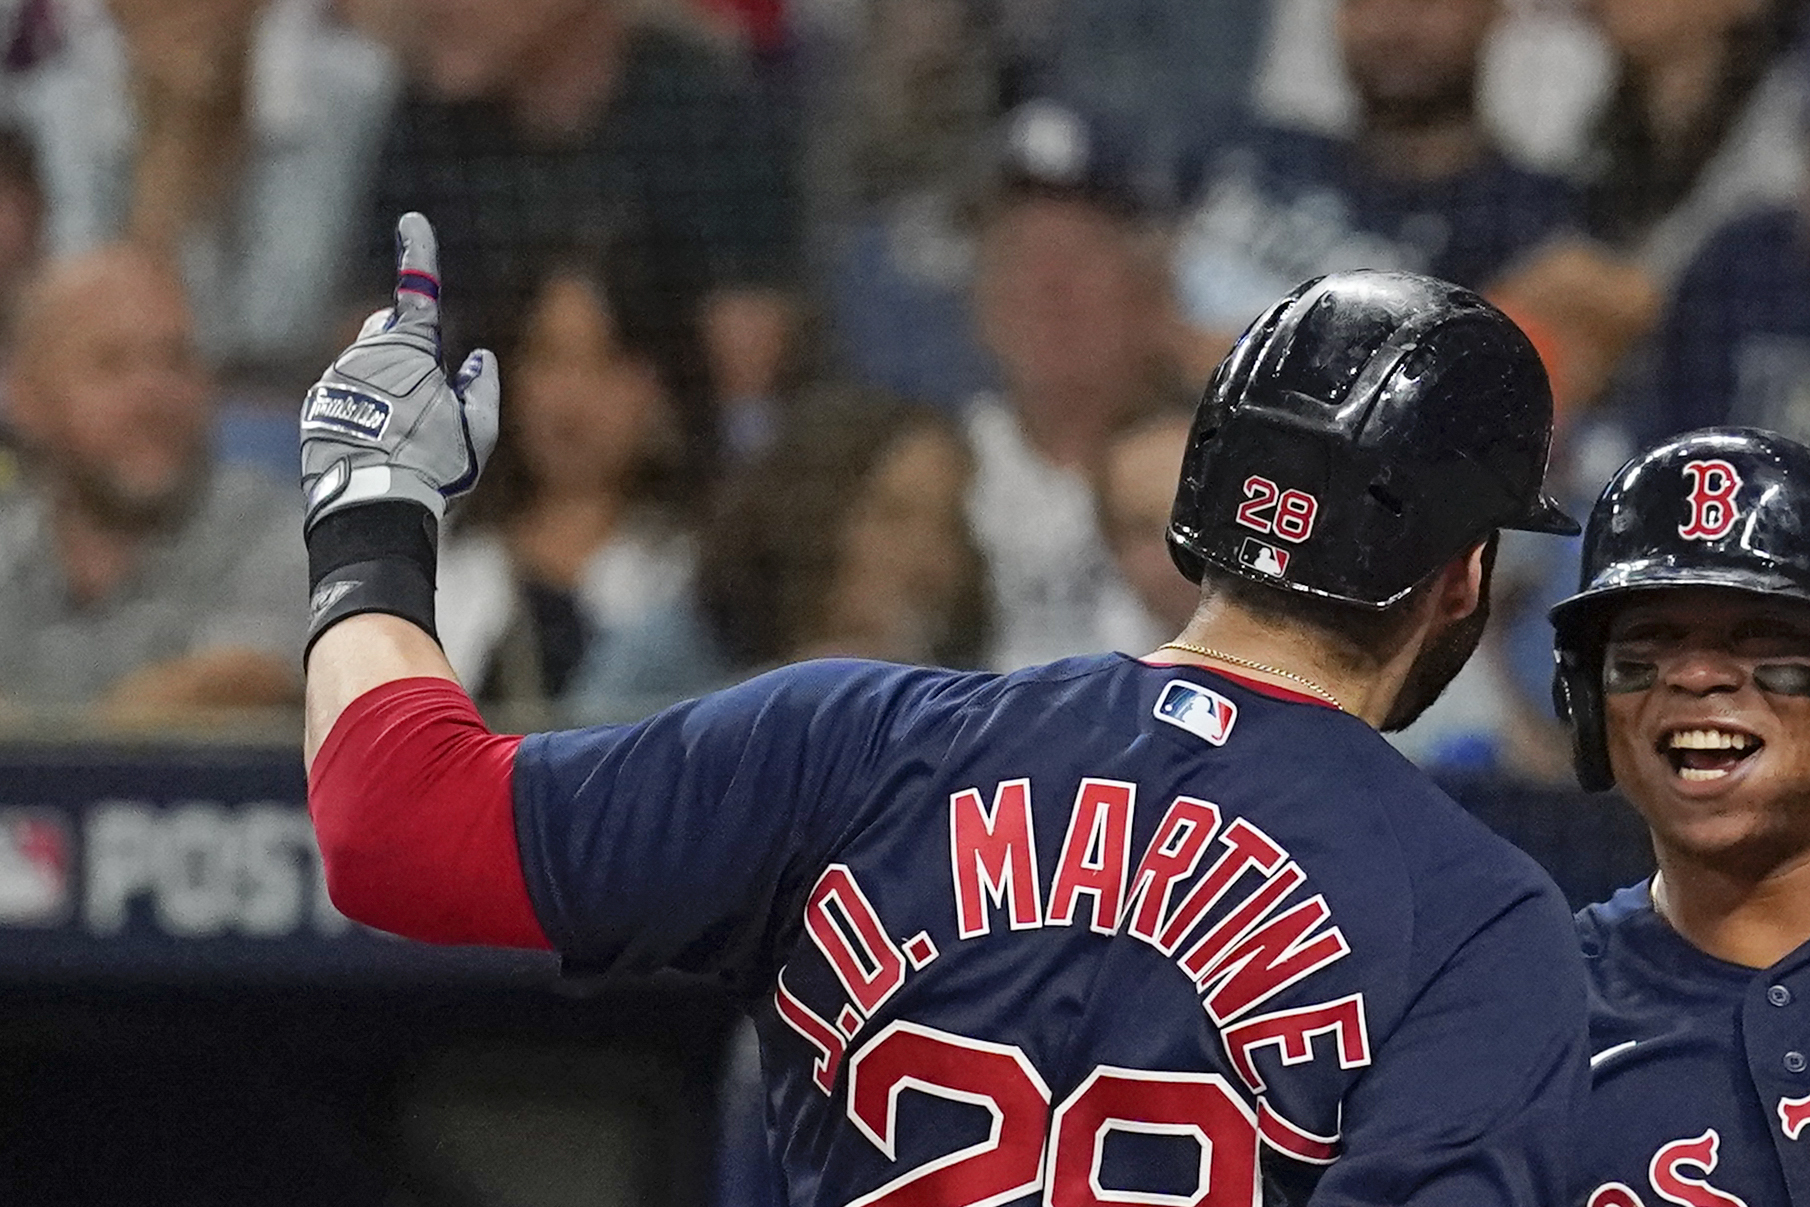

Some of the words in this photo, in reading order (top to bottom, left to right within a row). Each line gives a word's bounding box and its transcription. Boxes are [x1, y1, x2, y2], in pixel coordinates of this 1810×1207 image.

[1235, 474, 1318, 543] 28
[1677, 459, 1743, 541] B
[774, 864, 940, 1097] J.D.
